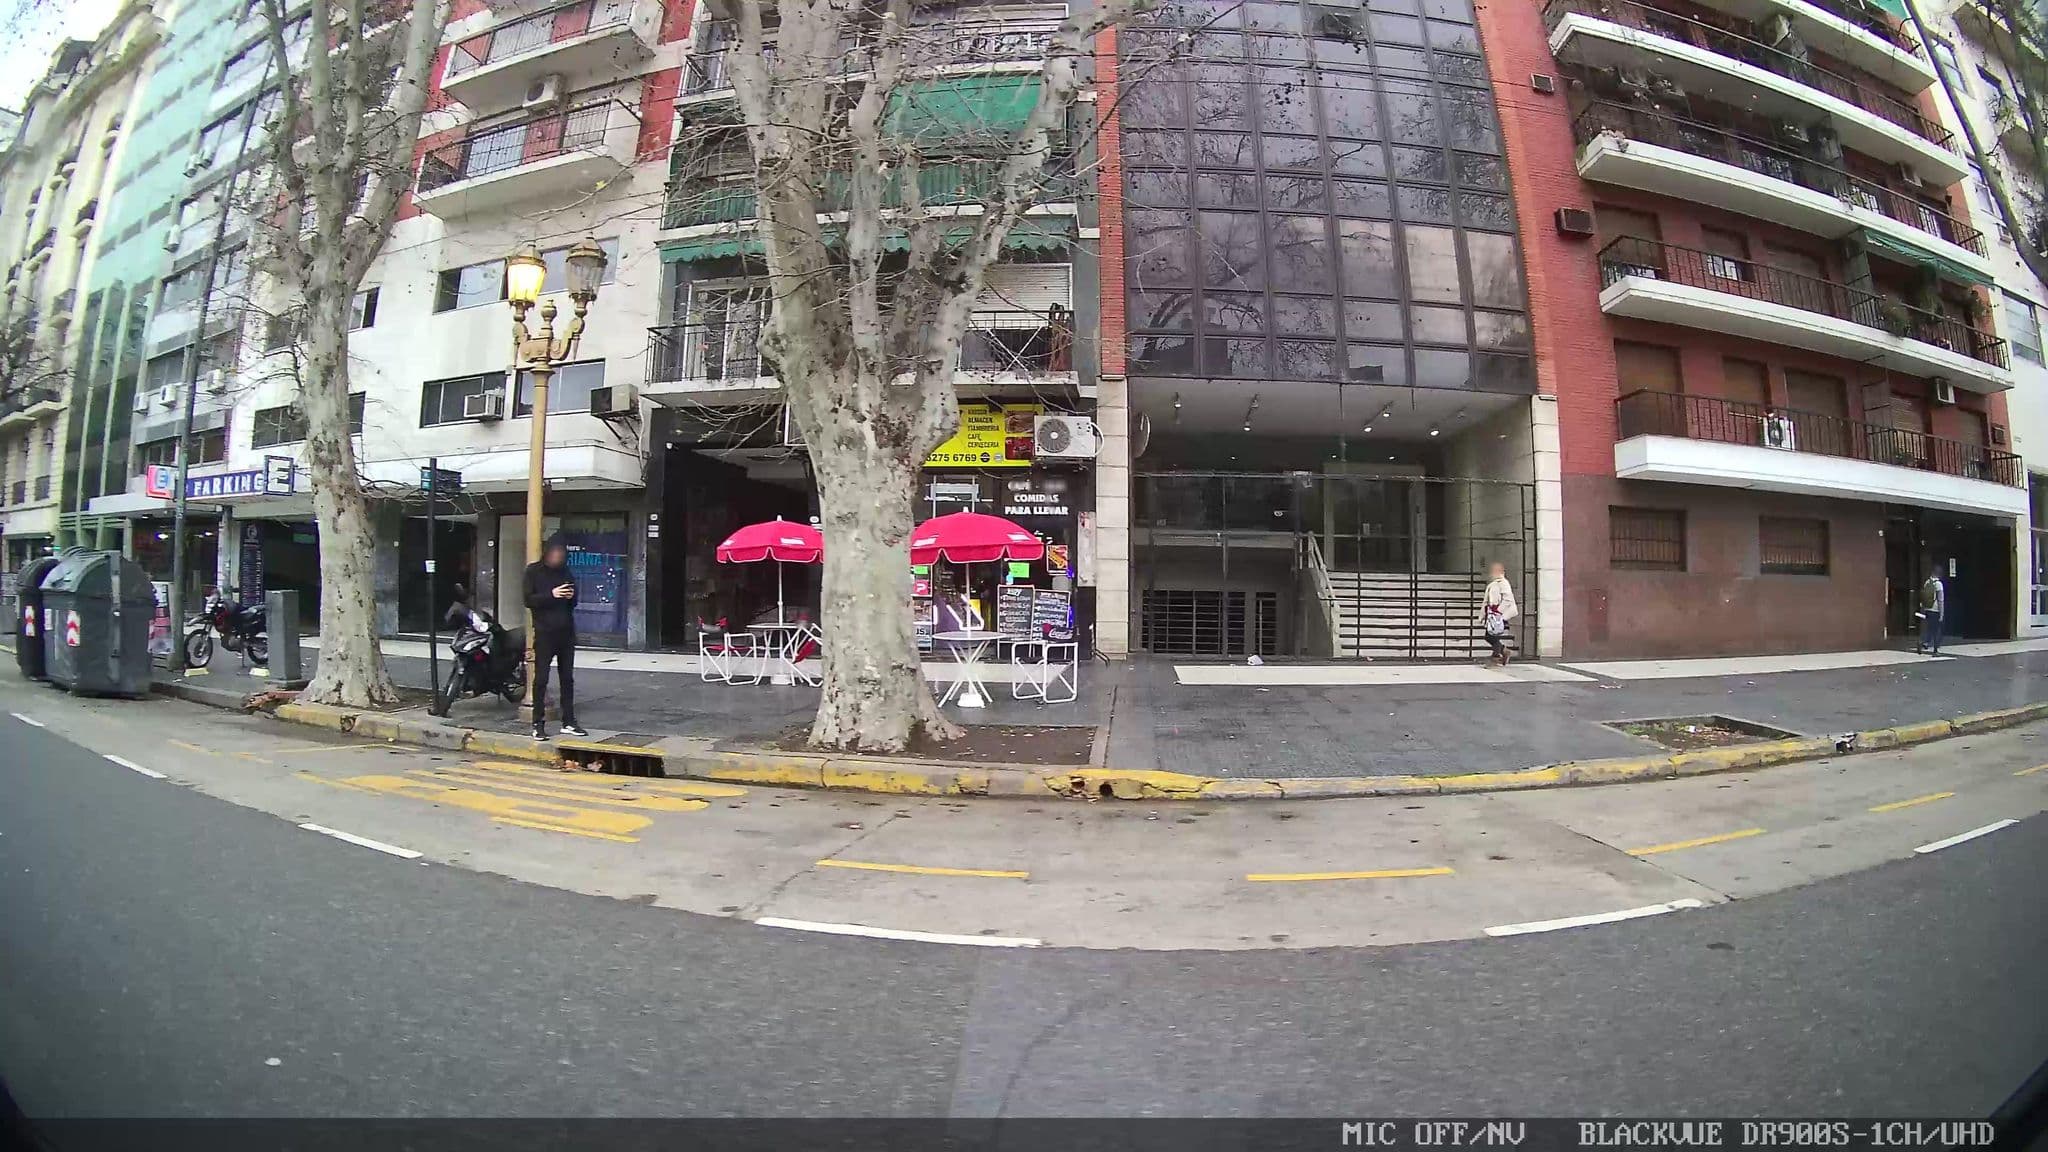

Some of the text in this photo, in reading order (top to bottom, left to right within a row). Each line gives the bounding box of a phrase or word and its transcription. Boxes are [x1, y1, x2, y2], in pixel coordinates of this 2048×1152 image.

[952, 453, 977, 462] 6769
[193, 473, 264, 496] PARKING
[1004, 506, 1031, 515] PARA
